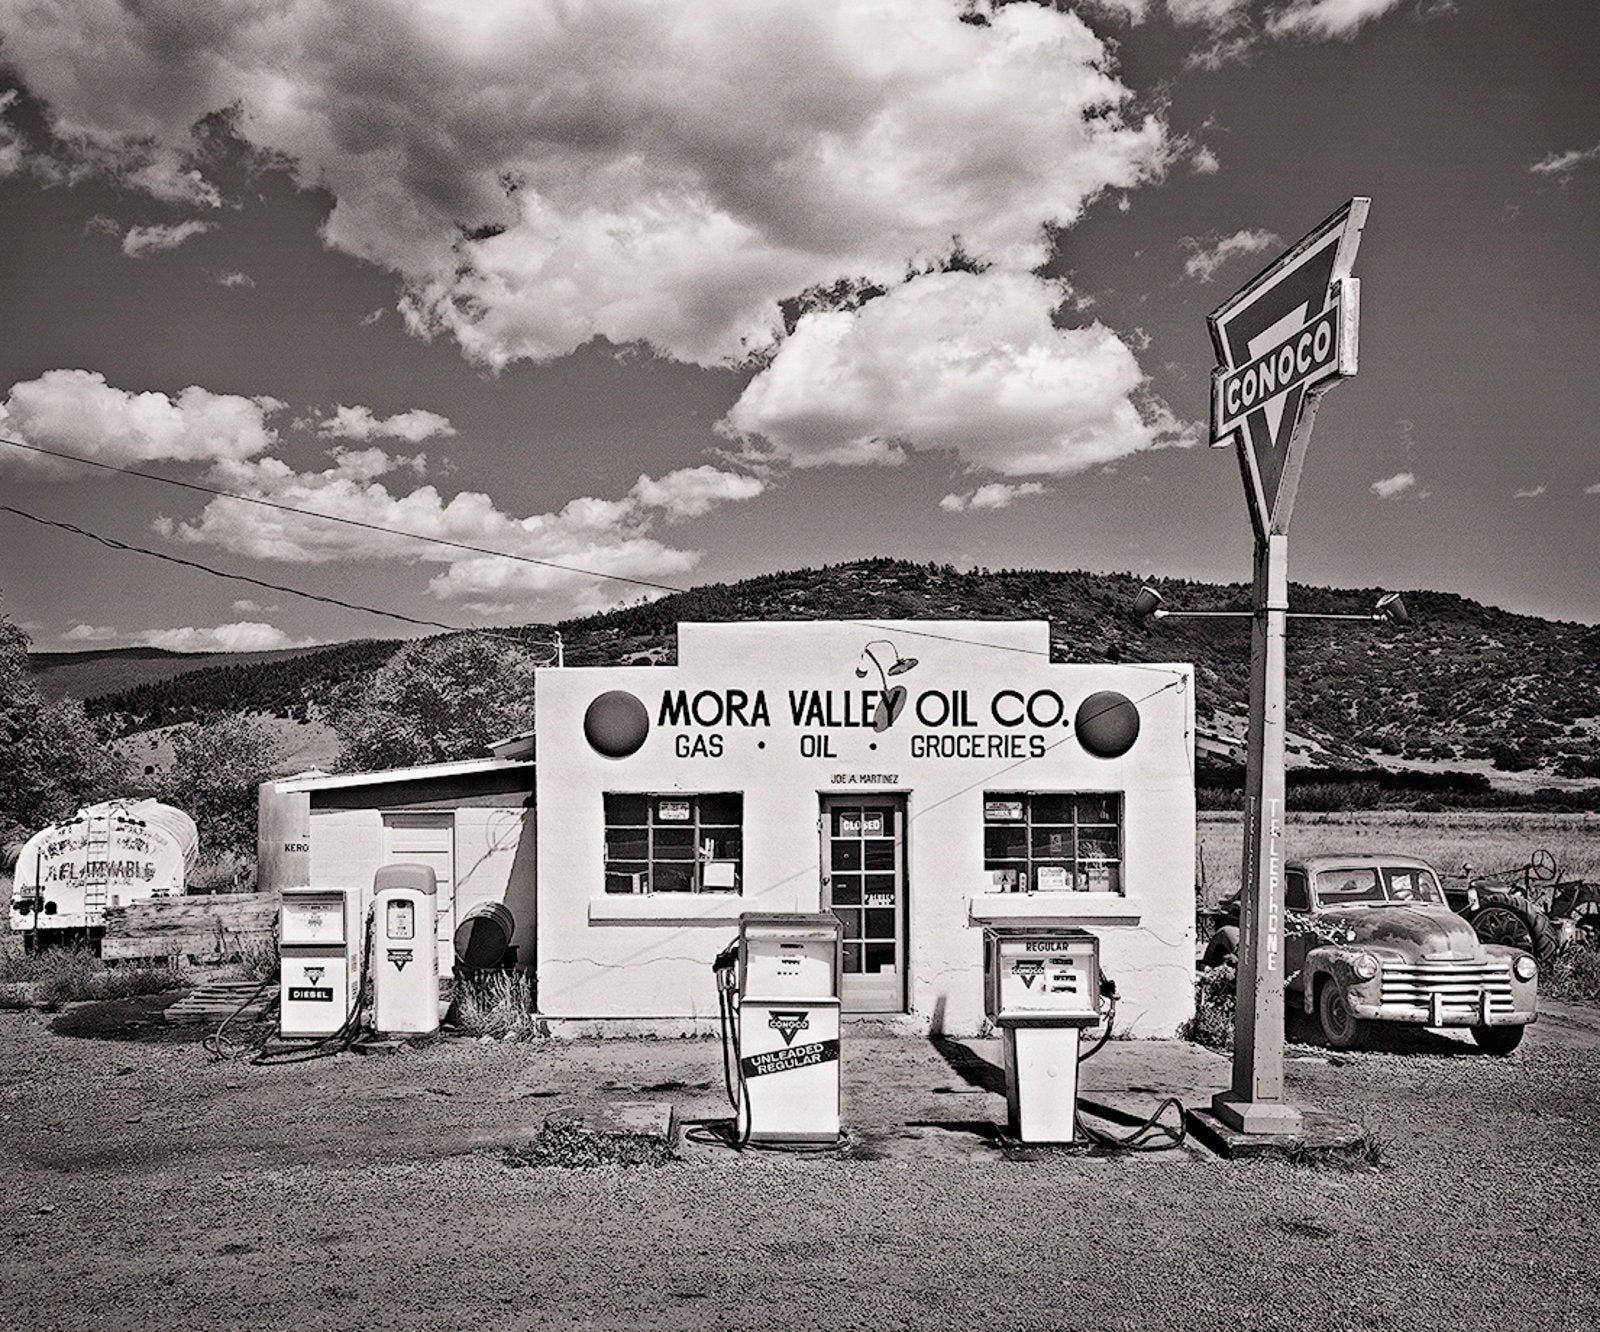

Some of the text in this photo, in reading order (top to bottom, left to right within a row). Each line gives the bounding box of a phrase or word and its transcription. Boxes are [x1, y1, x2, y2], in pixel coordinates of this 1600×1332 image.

[1227, 320, 1332, 415] CONOCO
[657, 688, 1070, 729] MORA VALLEY OIL CO.
[675, 733, 1046, 759] GAS OIL GROCERIES
[831, 774, 846, 784] JOE
[859, 774, 900, 784] MARTINEZ
[1025, 941, 1070, 952] REGULAR
[293, 989, 329, 999] DIESEL
[769, 1019, 809, 1030] CONOCO
[750, 1043, 825, 1066] UNLEADED
[757, 1053, 822, 1076] REGULAR
